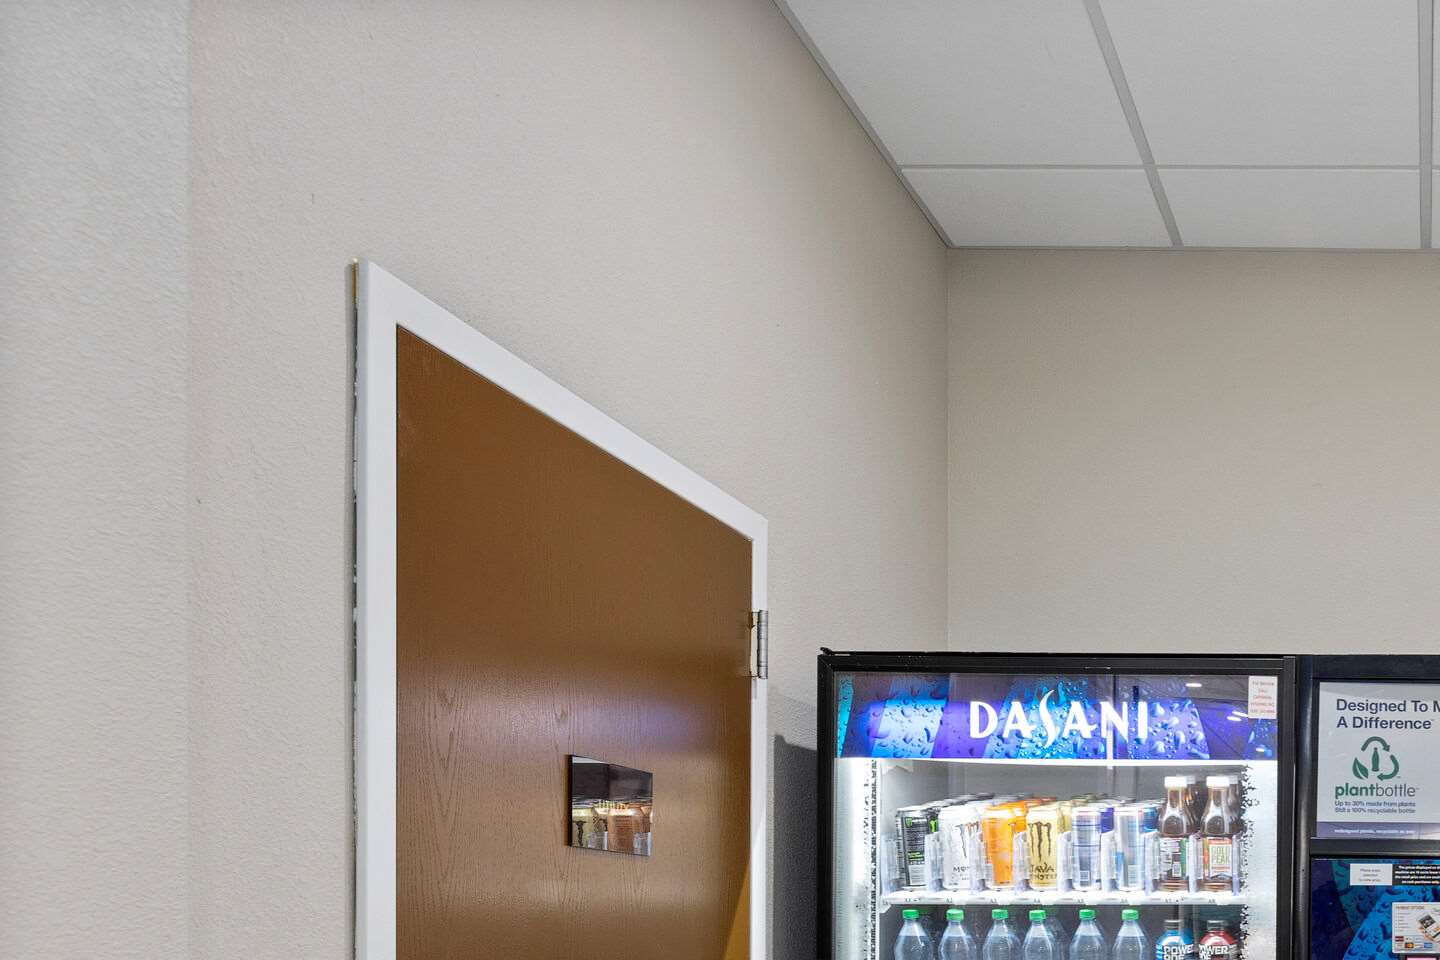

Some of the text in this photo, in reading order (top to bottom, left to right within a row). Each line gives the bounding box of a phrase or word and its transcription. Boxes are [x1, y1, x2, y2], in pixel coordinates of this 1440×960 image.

[1336, 698, 1406, 714] Designed
[1411, 700, 1428, 713] To
[969, 690, 1148, 749] DASANI
[1336, 716, 1433, 730] A Difference
[1335, 783, 1416, 799] plantbottle
